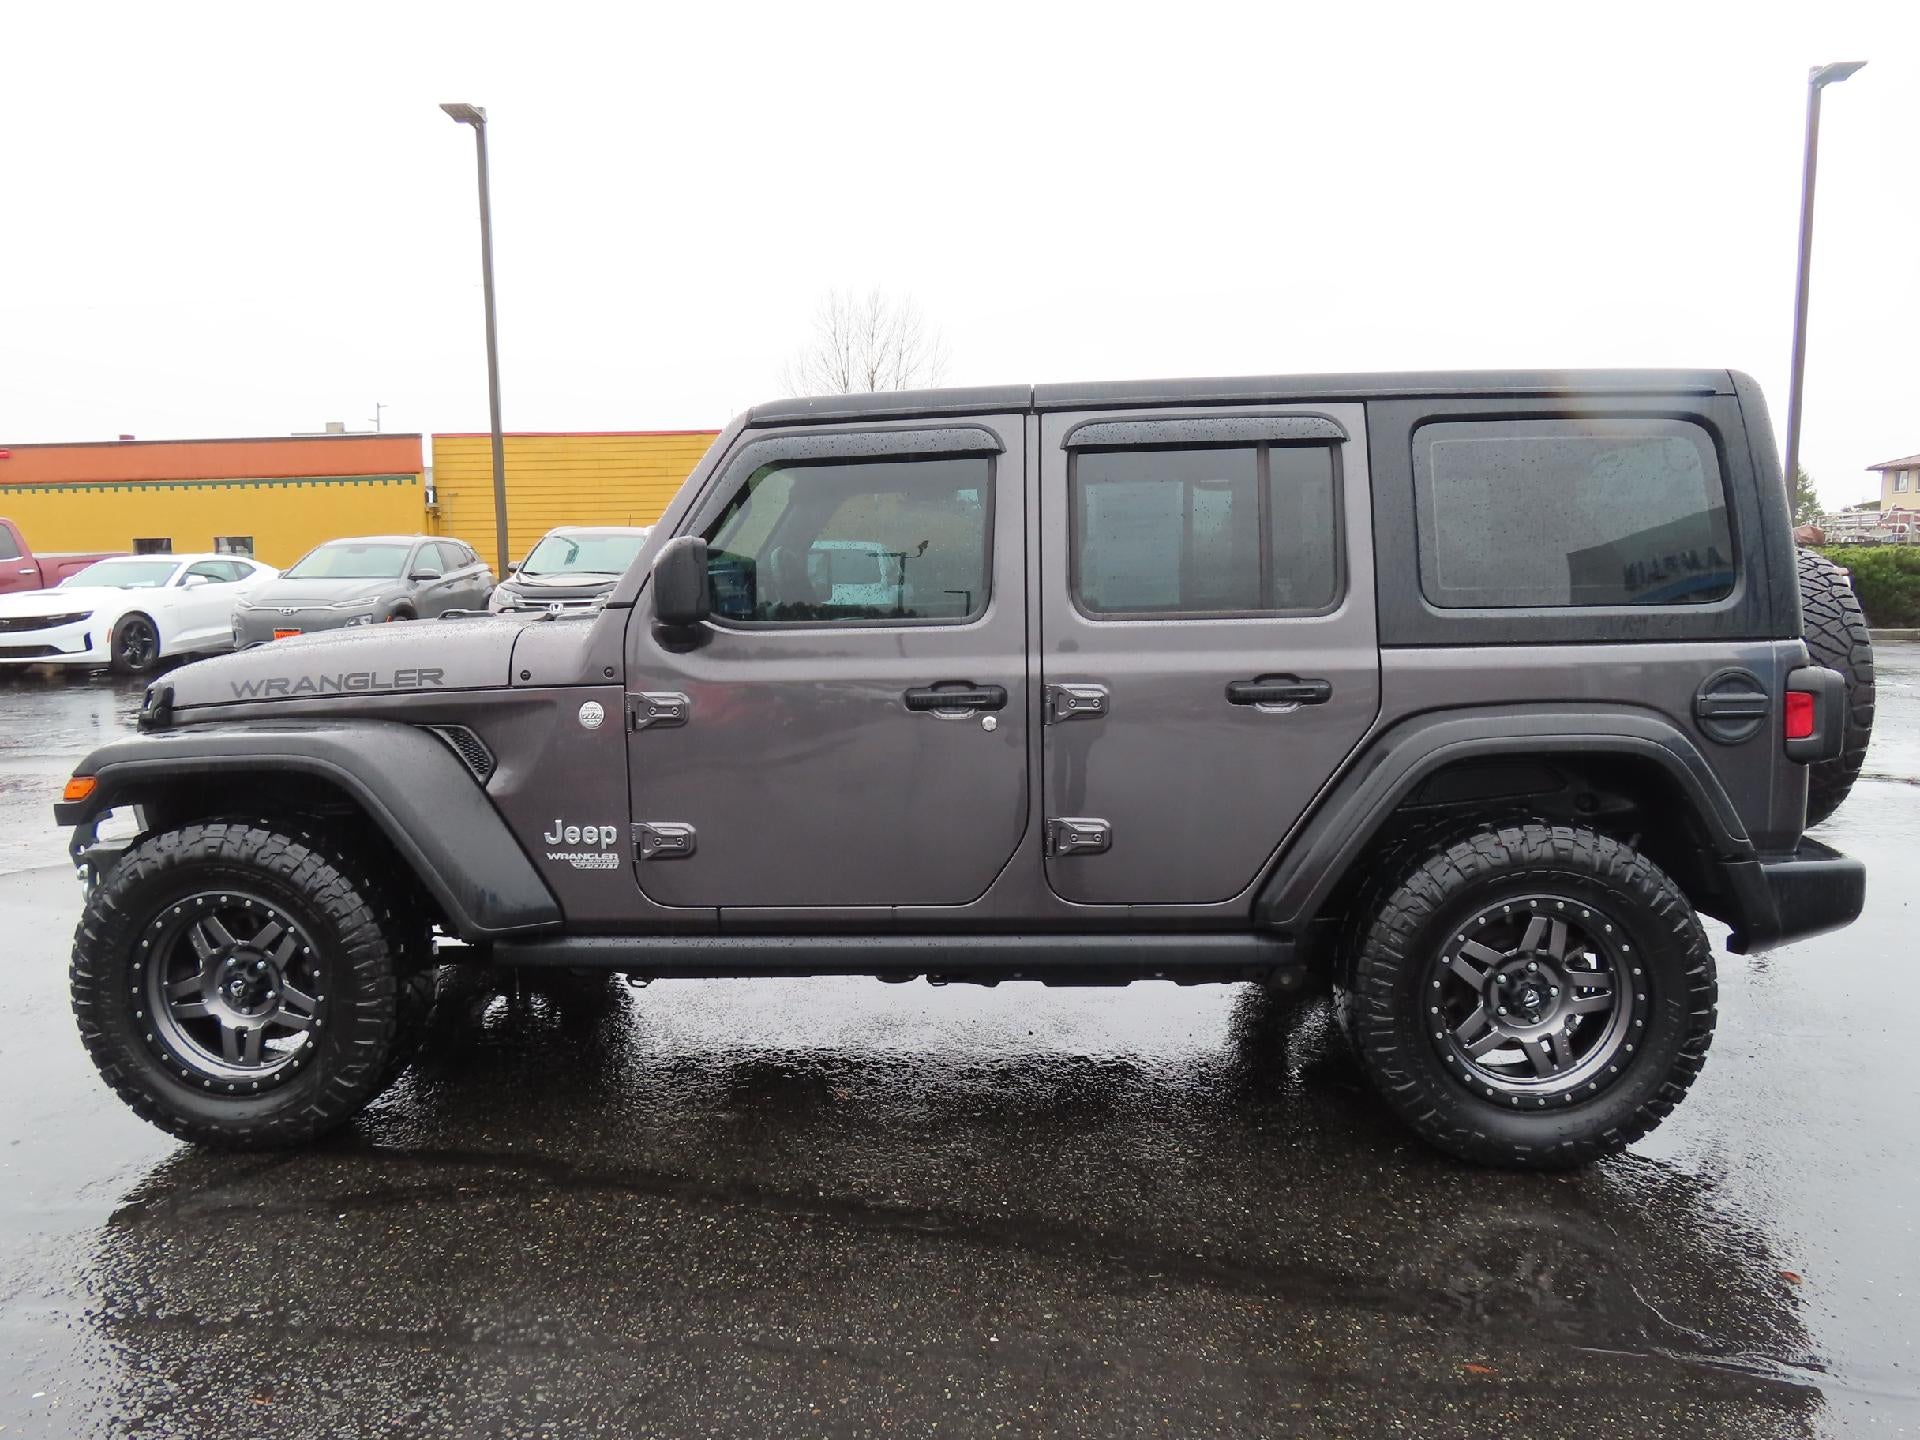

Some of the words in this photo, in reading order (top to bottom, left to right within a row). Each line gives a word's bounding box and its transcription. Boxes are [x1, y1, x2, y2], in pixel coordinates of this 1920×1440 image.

[230, 667, 445, 698] WRANGLER
[543, 819, 618, 850] Jeep
[546, 852, 619, 860] WRANGLER
